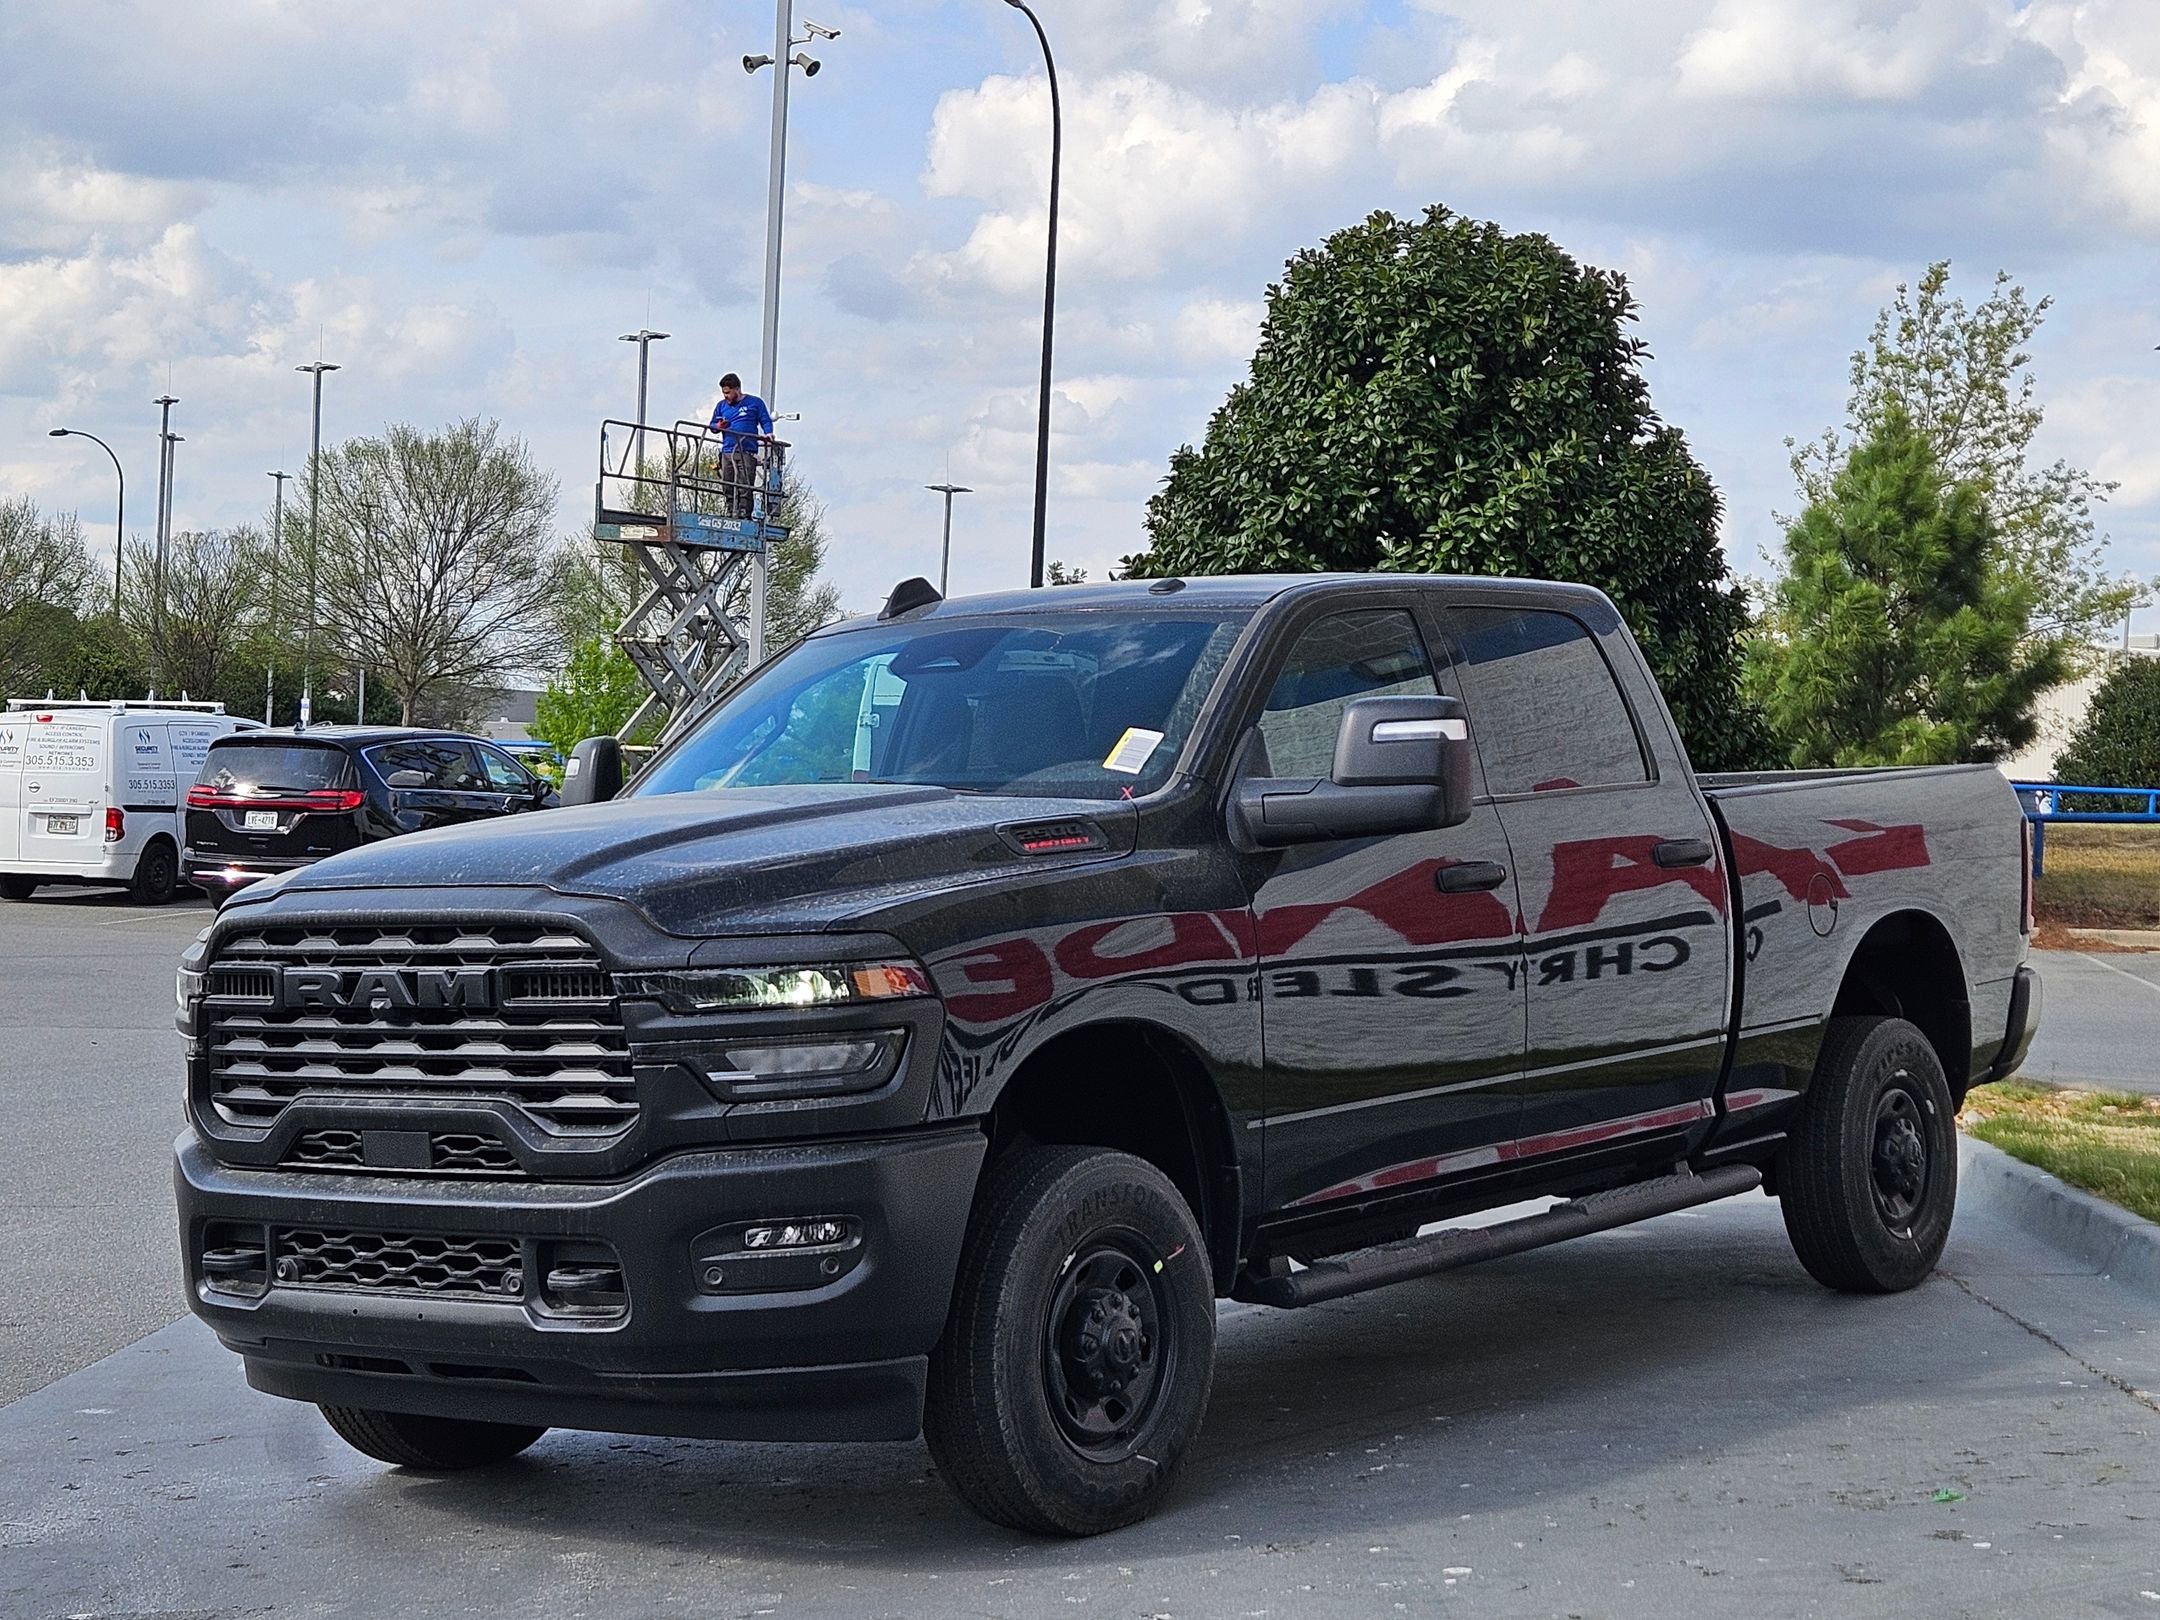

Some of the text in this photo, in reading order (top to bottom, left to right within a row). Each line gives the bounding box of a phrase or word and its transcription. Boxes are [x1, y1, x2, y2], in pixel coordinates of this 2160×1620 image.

[712, 518, 722, 528] GS
[722, 519, 742, 532] 2032
[25, 755, 95, 767] 305.515.3353
[128, 779, 176, 790] 305.515.3353
[284, 967, 489, 1009] RAM
